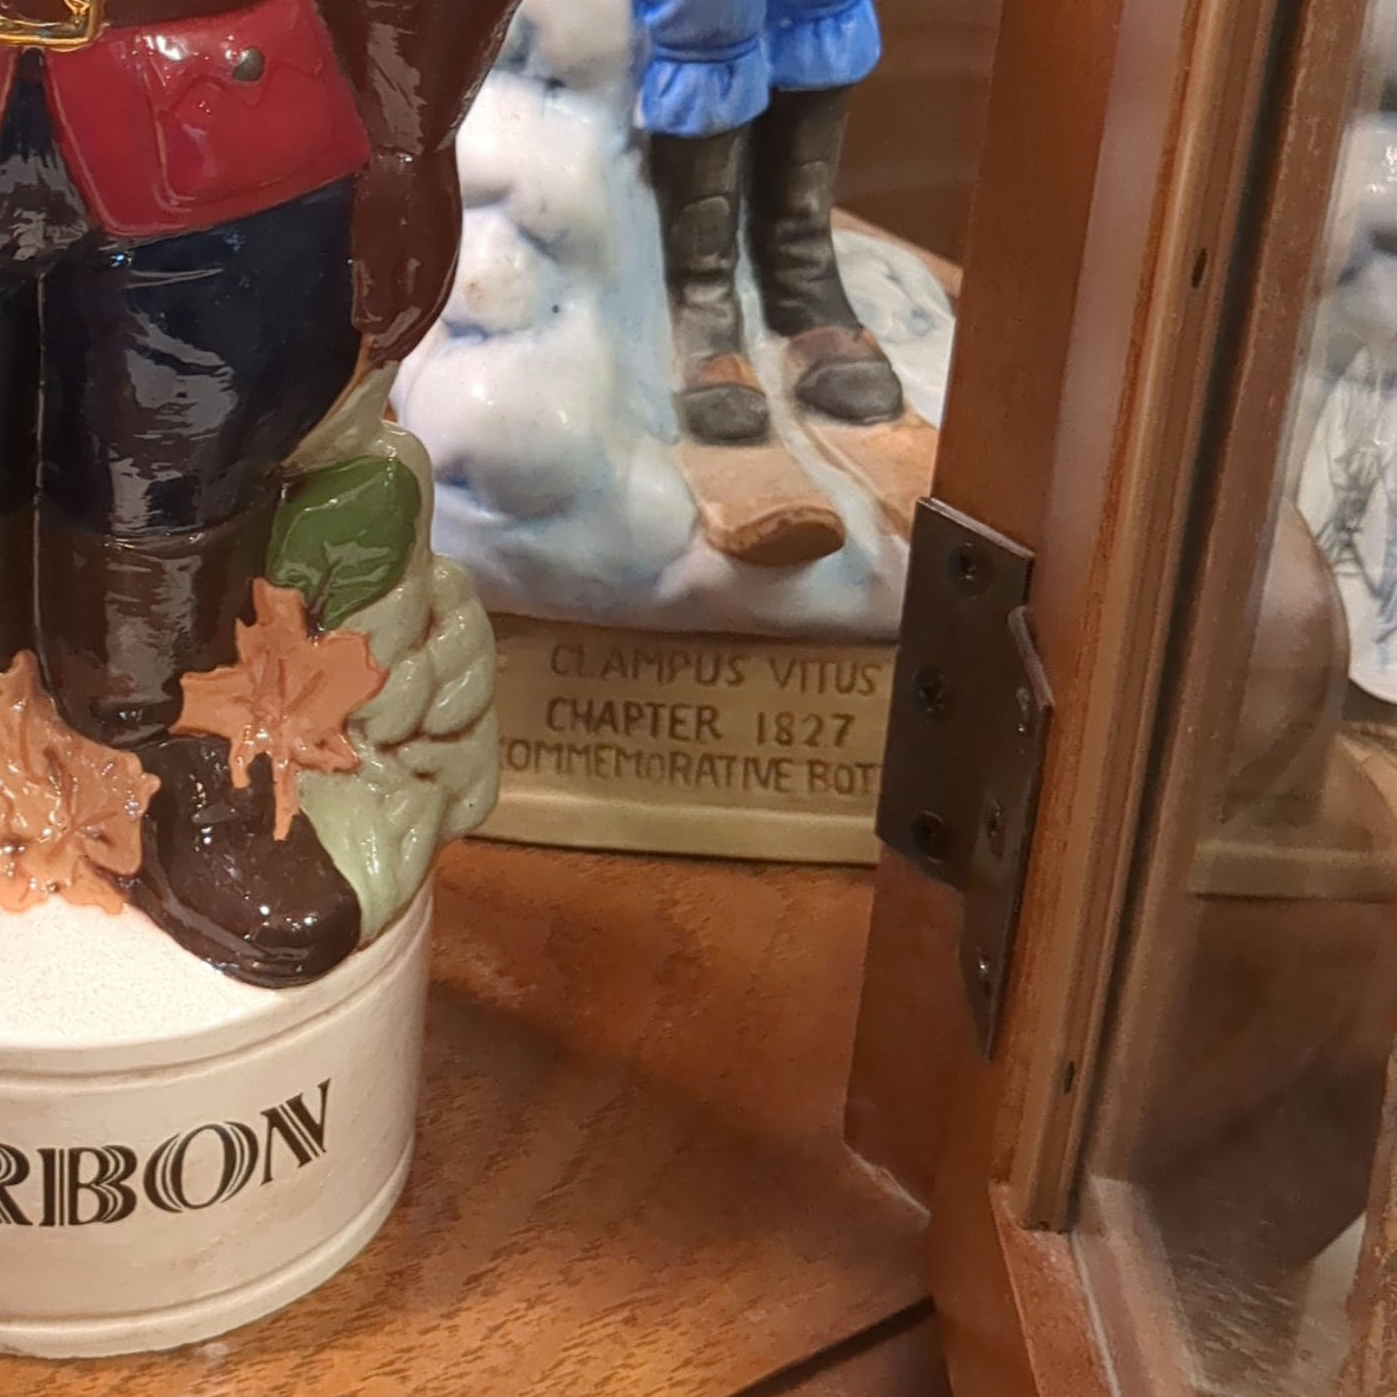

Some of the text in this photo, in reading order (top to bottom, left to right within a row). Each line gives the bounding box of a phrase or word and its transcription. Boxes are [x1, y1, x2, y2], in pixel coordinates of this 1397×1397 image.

[549, 642, 750, 688] CLAMPUS
[768, 657, 881, 697] VITUS
[545, 695, 857, 749] CHAPTER 1827
[499, 736, 883, 795] OMMEMORATIVE BOT
